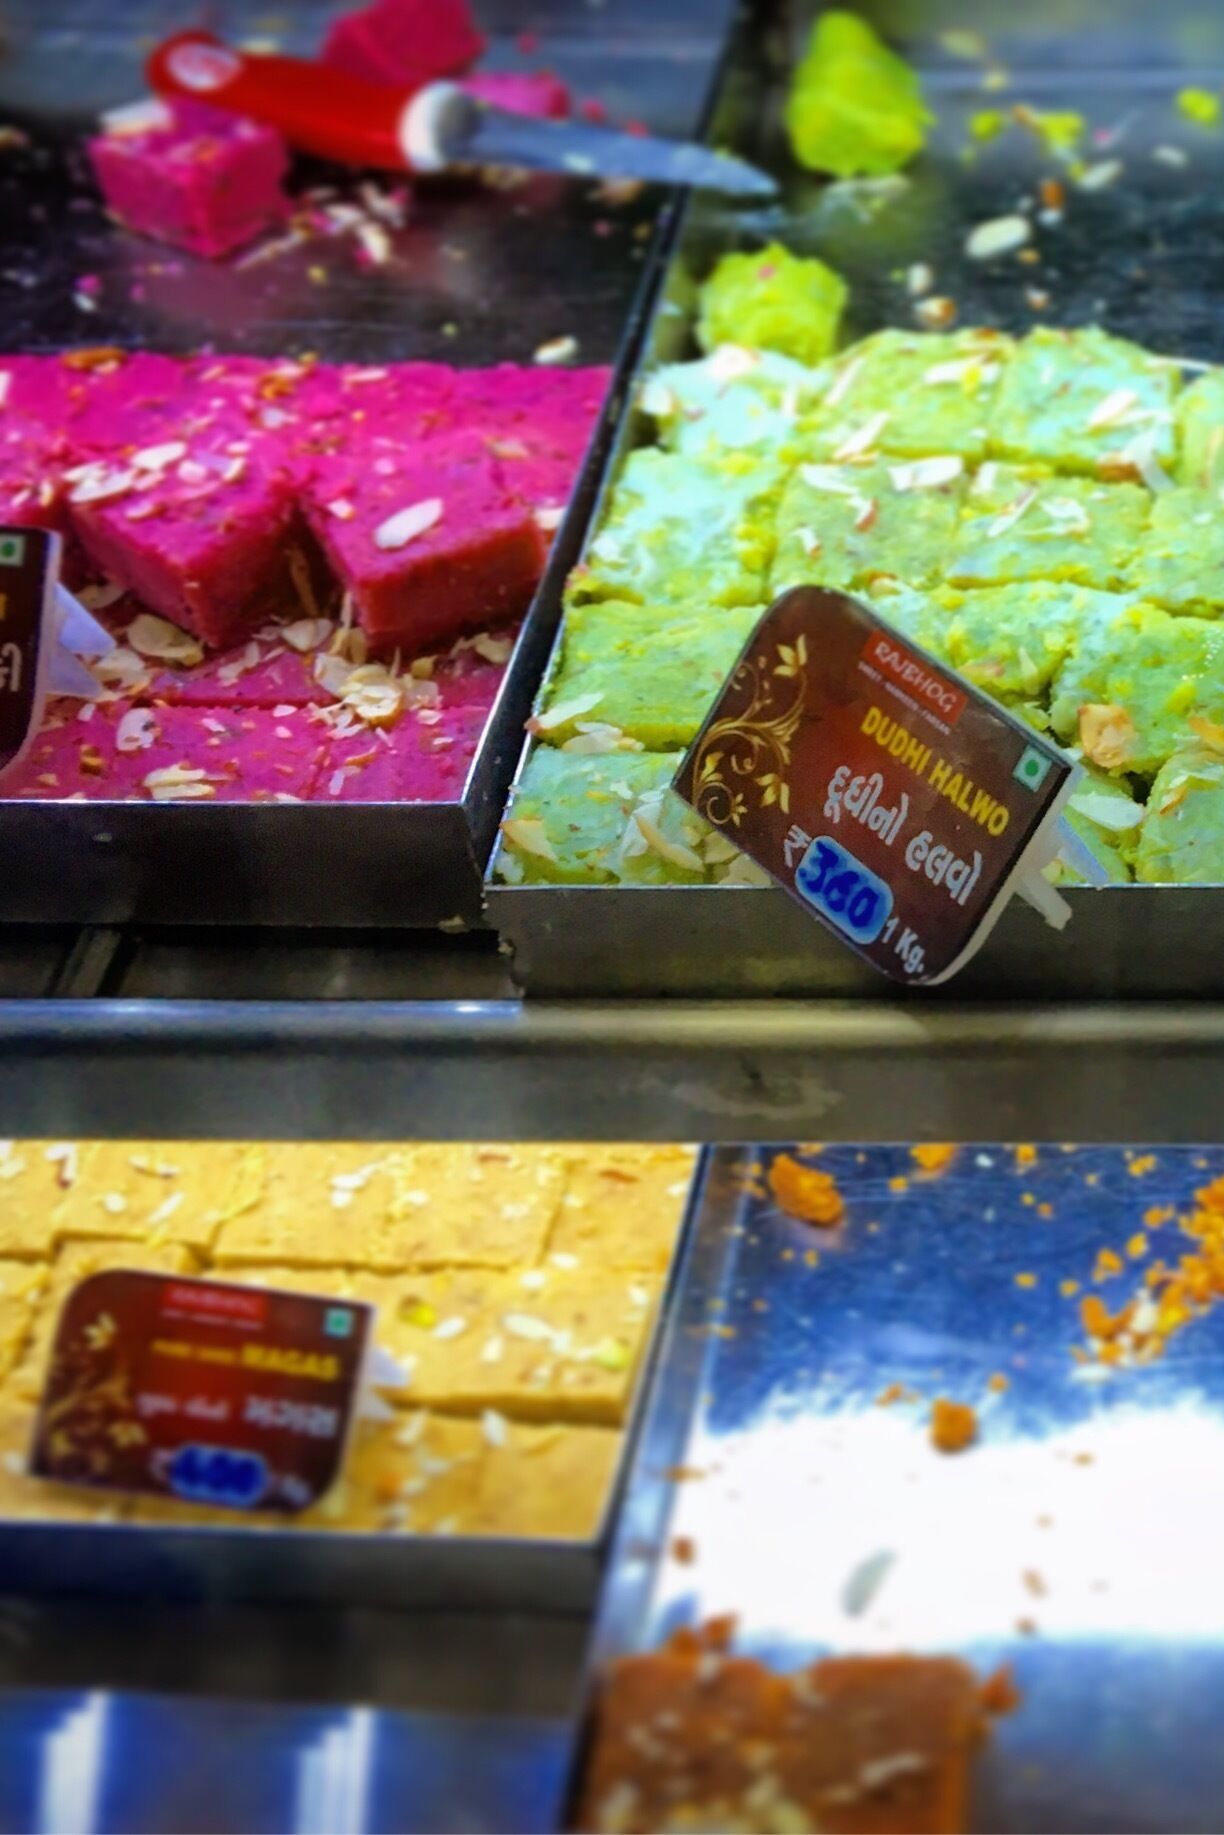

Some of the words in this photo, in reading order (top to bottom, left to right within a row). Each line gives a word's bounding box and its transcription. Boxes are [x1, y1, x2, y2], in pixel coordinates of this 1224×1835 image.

[875, 641, 957, 713] RAJBHOG
[860, 706, 932, 775] DUDHI
[928, 759, 1010, 837] HALWO
[823, 765, 909, 846] દૂધીનો
[905, 830, 982, 906] હલવો
[894, 927, 925, 974] Kg.
